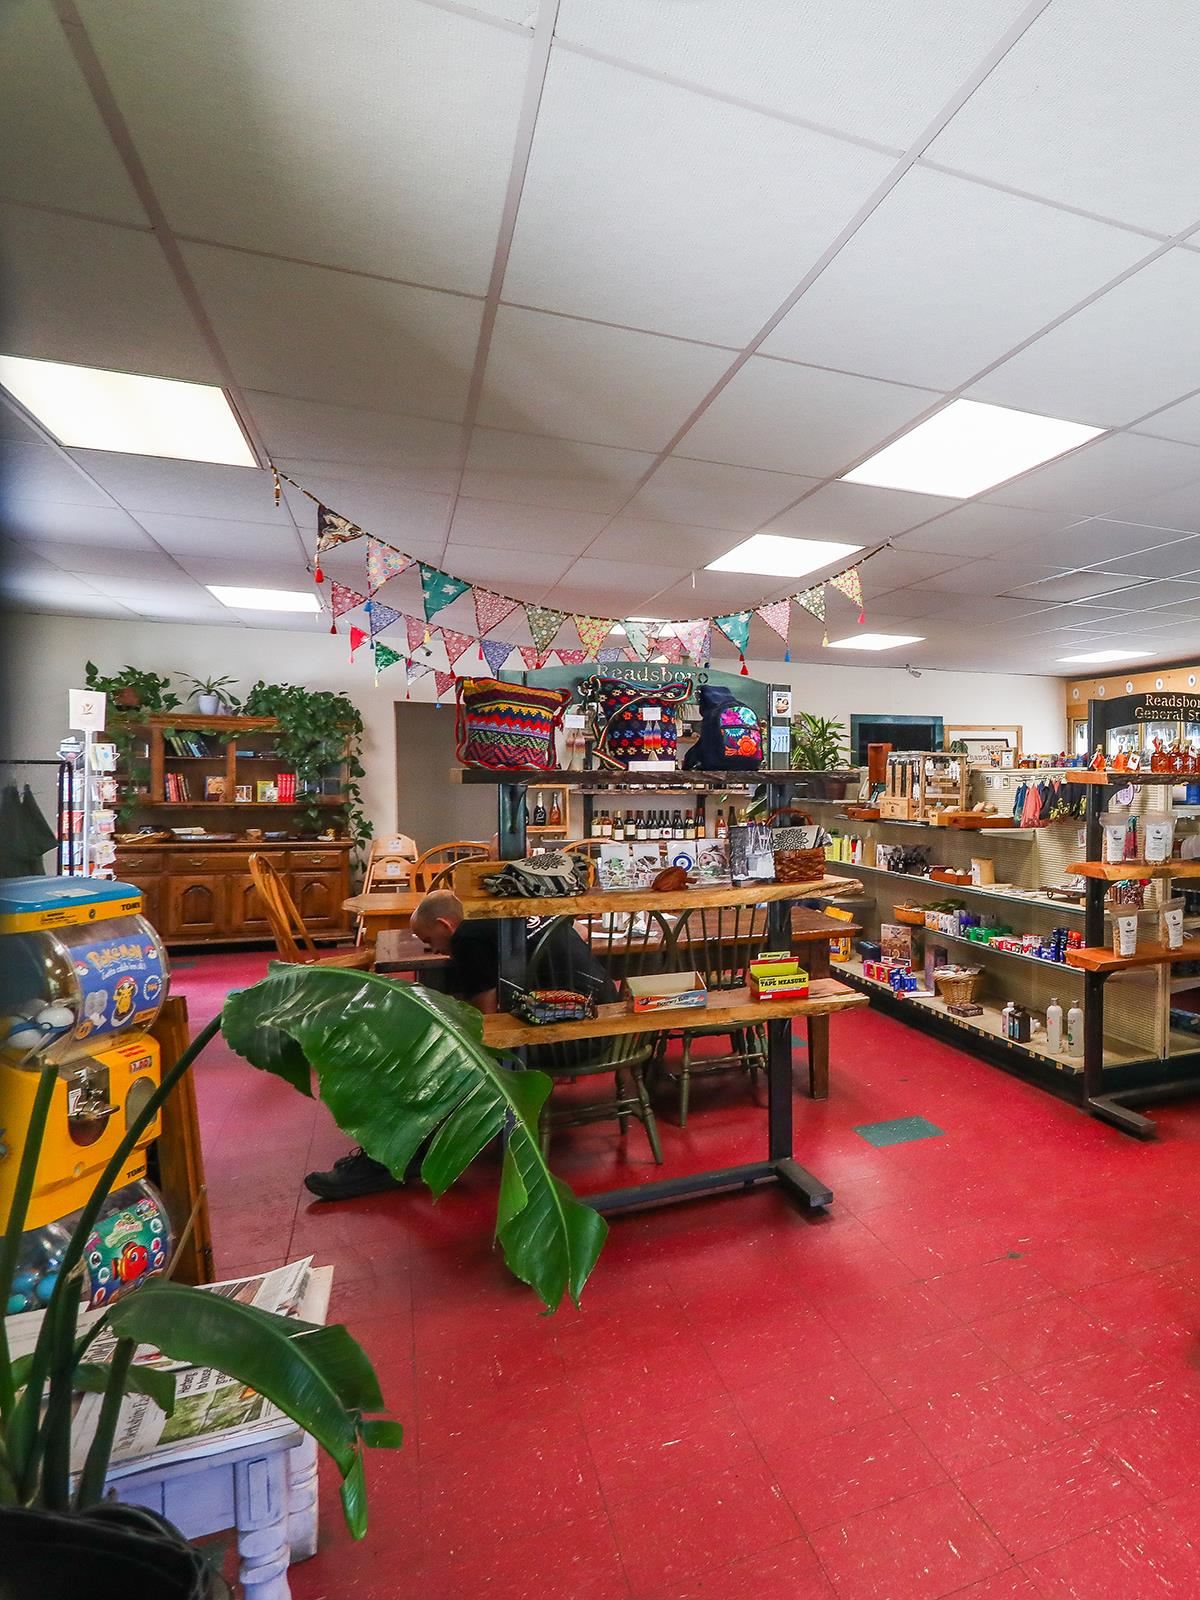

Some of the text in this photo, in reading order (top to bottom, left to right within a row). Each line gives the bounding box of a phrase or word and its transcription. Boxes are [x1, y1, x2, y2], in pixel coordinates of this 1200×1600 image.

[597, 664, 709, 685] Readsboro
[1134, 706, 1184, 721] General
[121, 902, 140, 911] TOMY
[777, 977, 807, 986] MEASURE
